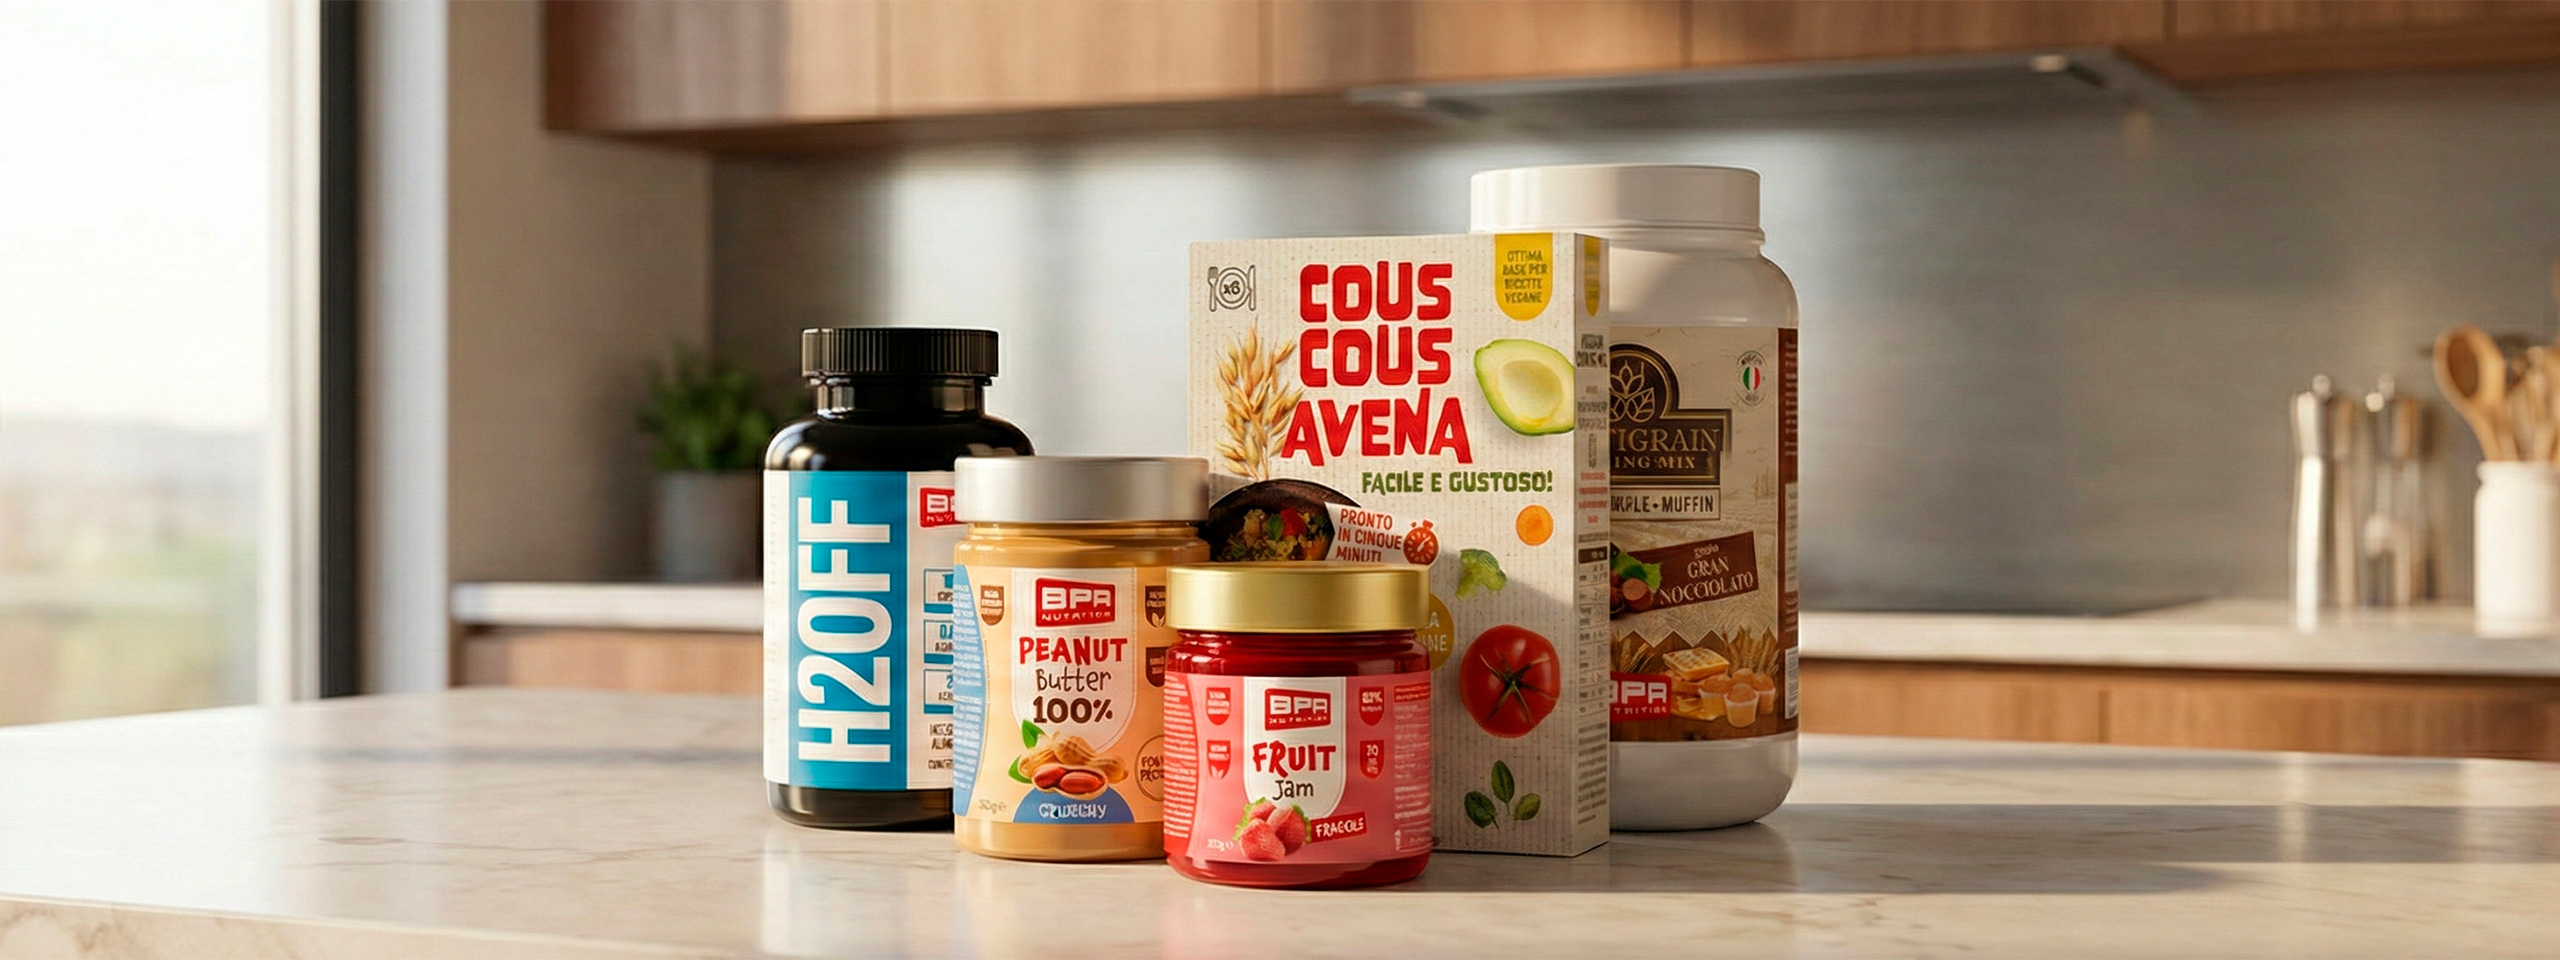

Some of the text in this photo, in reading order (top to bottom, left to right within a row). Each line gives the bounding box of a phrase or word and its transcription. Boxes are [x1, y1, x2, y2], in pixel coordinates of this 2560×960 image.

[1300, 261, 1453, 322] COUS
[1300, 325, 1453, 387] COUS
[1281, 388, 1473, 466] AVENA
[1362, 470, 1553, 496] FACILE E GUSTOSO!
[1662, 495, 1714, 512] MUFFIN
[1340, 508, 1393, 530] PRONTO
[1338, 526, 1402, 550] IN CINQUE
[1336, 546, 1382, 562] MINUTI
[1041, 587, 1111, 610] BPA
[798, 497, 891, 763] H2OFF
[1019, 636, 1128, 666] PEANUT
[1035, 666, 1111, 693] Butter
[1033, 696, 1113, 724] 100%
[1270, 695, 1328, 714] BPA
[1252, 740, 1337, 778] FRUIT
